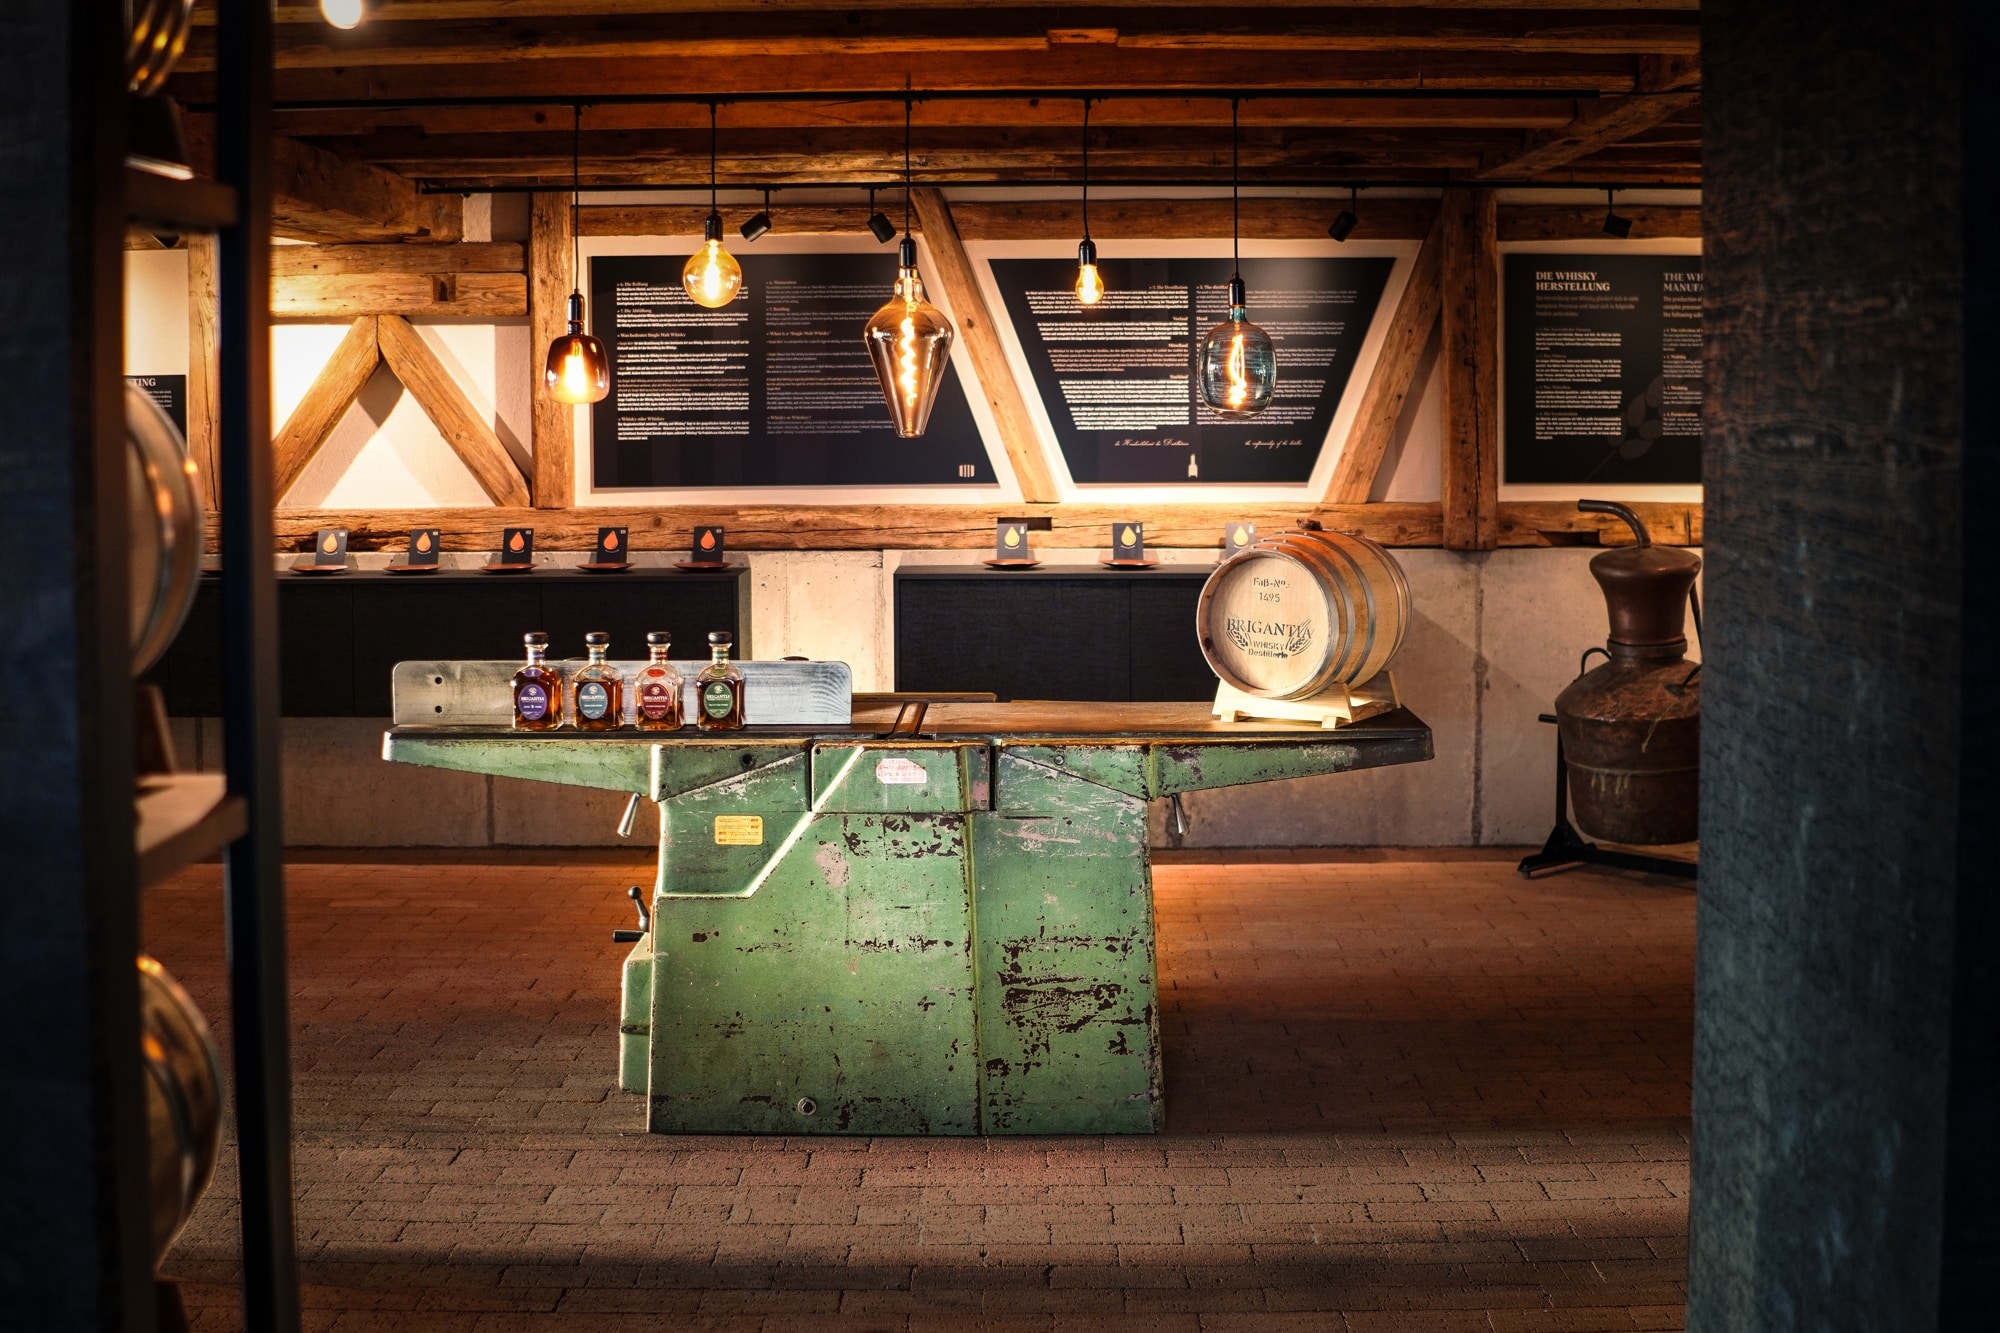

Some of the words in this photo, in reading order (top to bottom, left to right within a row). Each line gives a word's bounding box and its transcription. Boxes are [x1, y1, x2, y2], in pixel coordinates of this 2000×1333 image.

[1536, 272, 1554, 281] DIE
[1556, 272, 1598, 281] WHISKY
[1662, 272, 1684, 282] THE
[1536, 282, 1610, 292] HERSTELLUNG
[1259, 592, 1280, 602] 1495
[1227, 618, 1312, 639] BRIGANTIA
[1253, 640, 1285, 650] WHISKY
